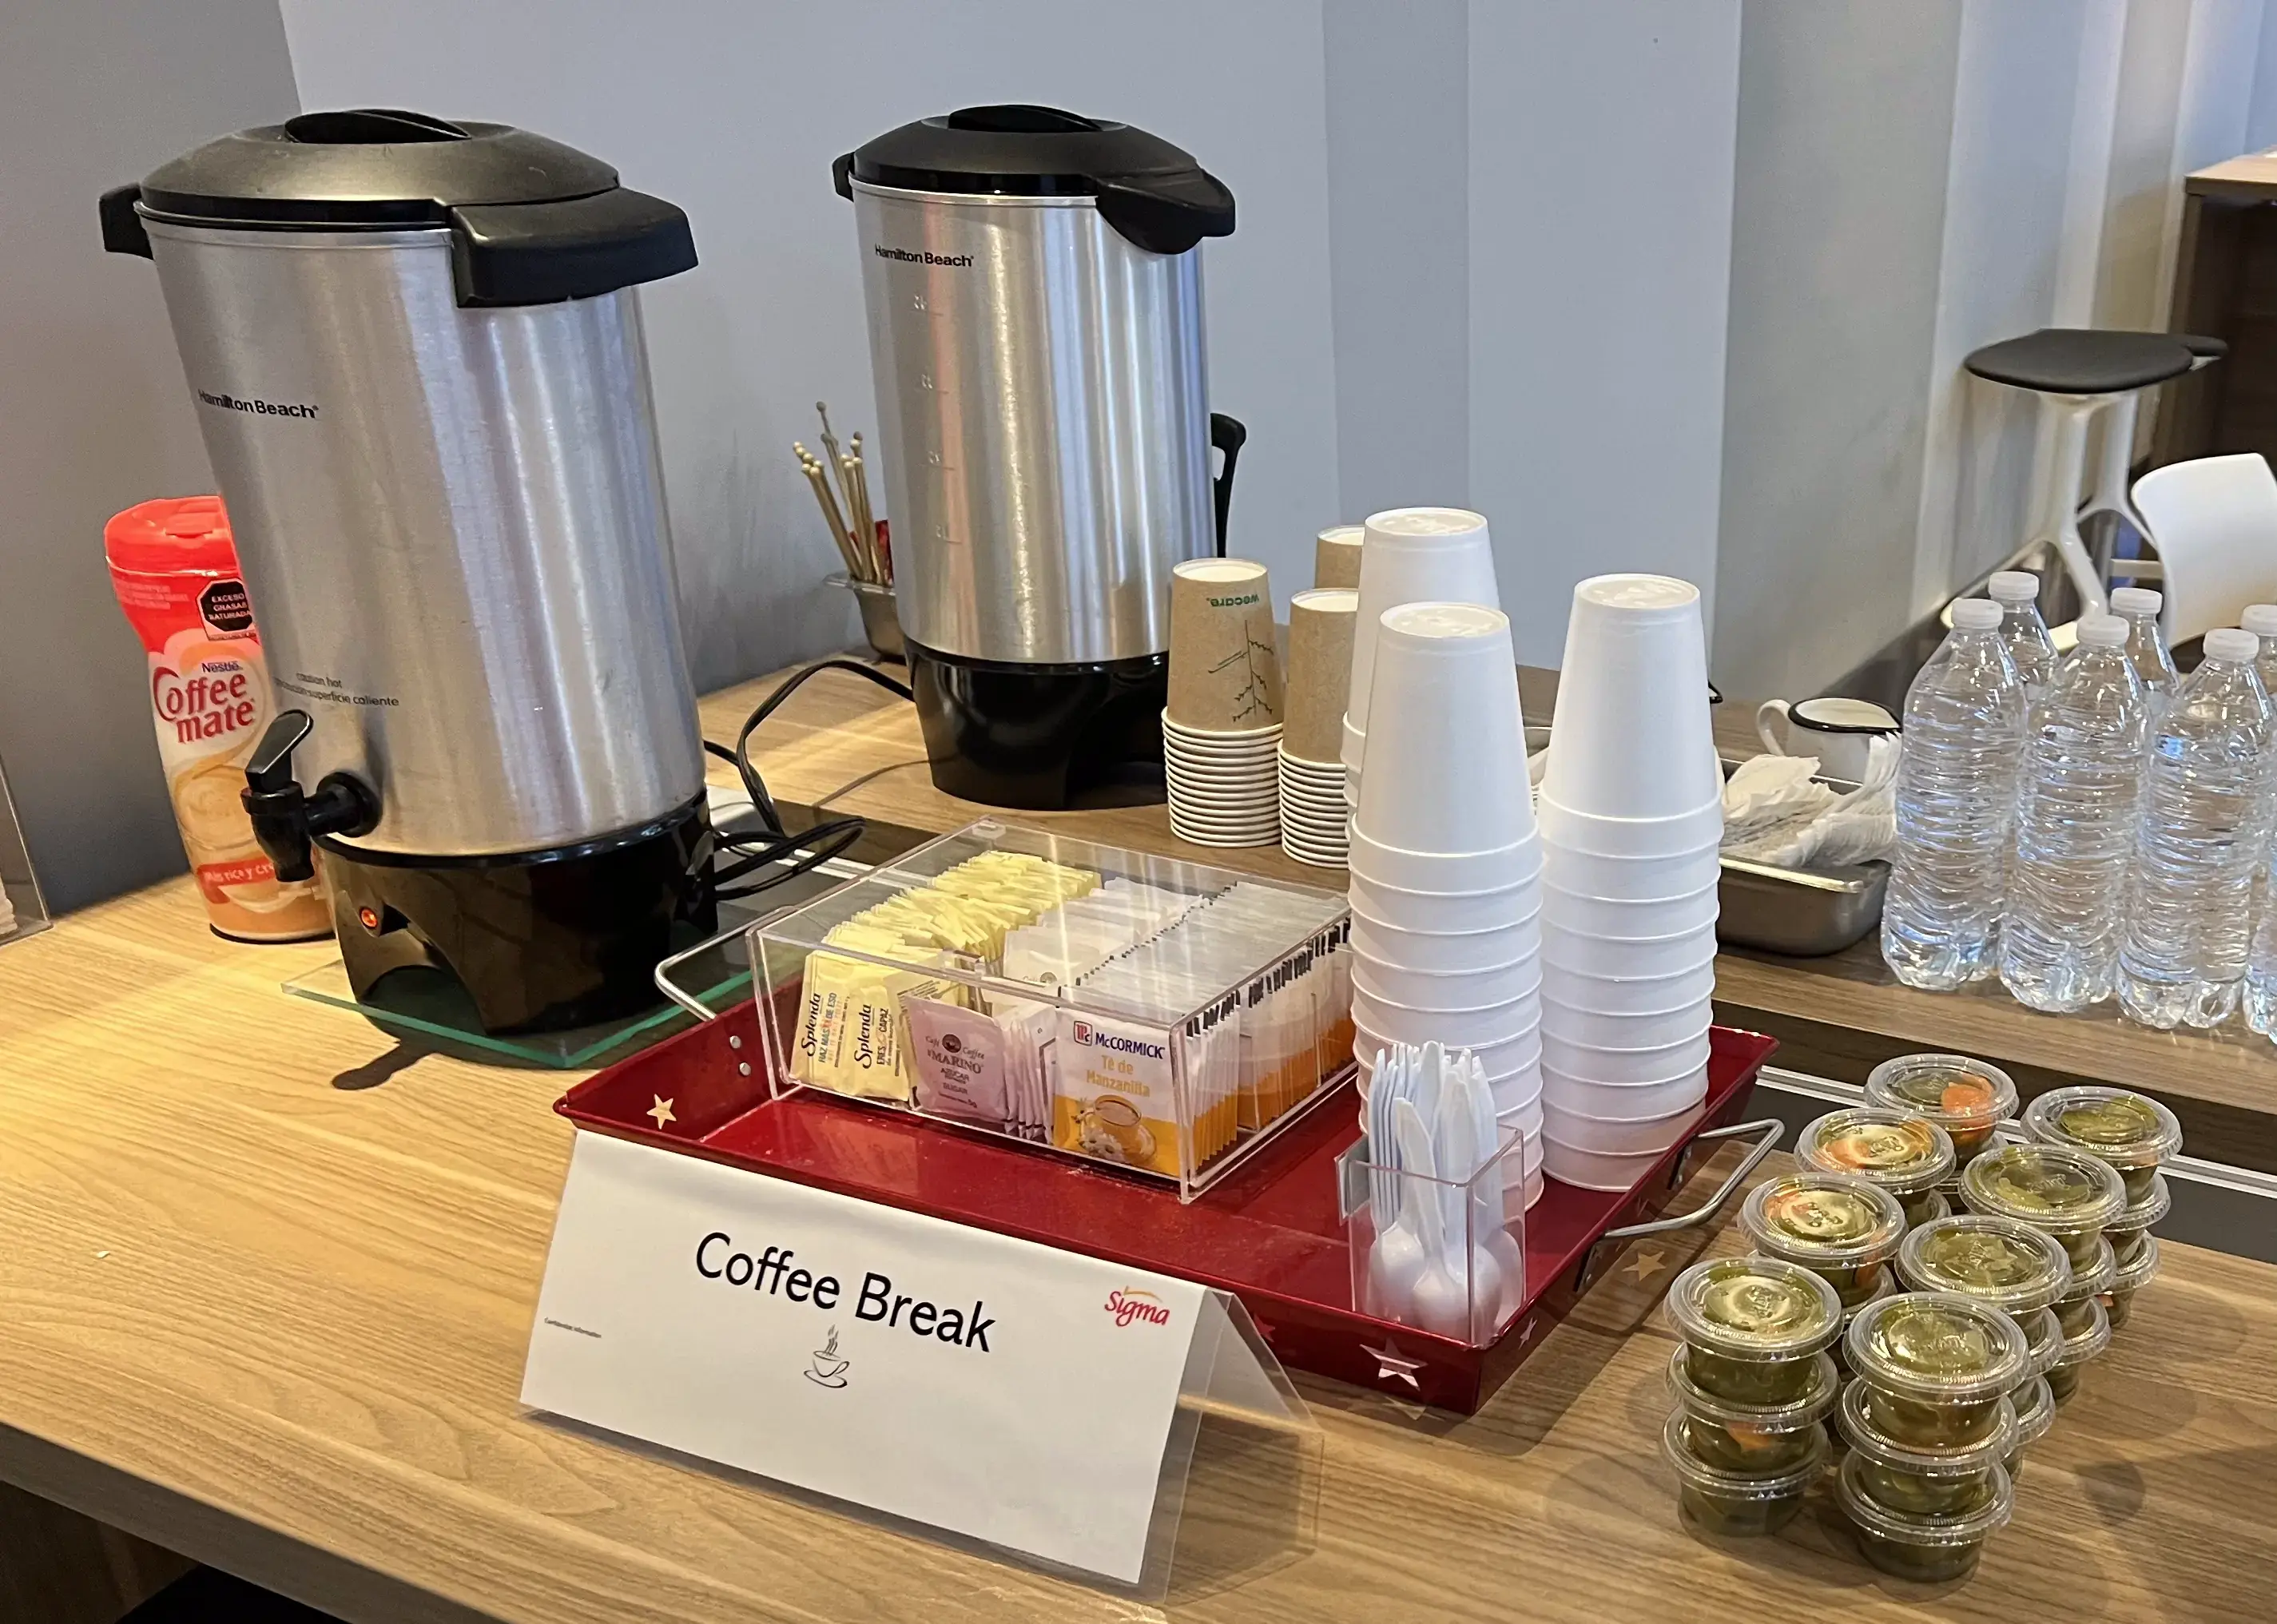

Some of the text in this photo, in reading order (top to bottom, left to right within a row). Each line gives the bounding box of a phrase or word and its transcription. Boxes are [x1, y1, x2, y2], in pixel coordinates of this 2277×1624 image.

[875, 243, 923, 264] Hamilton
[198, 389, 254, 413] Hamilton
[211, 593, 244, 603] EXCESO
[153, 666, 246, 722] Coffee
[326, 677, 343, 689] hot
[352, 695, 399, 706] caliente
[175, 701, 253, 744] mate
[801, 993, 821, 1057] Splenda
[818, 1046, 828, 1063] HAZ
[828, 992, 837, 1007] ESO
[854, 1003, 872, 1069] Splenda
[1095, 1032, 1165, 1059] McCORMICK
[1119, 1060, 1134, 1074] de
[1087, 1070, 1150, 1098] Manzanilla
[696, 1232, 996, 1353] Coffee Break
[1105, 1289, 1170, 1328] Sigma
